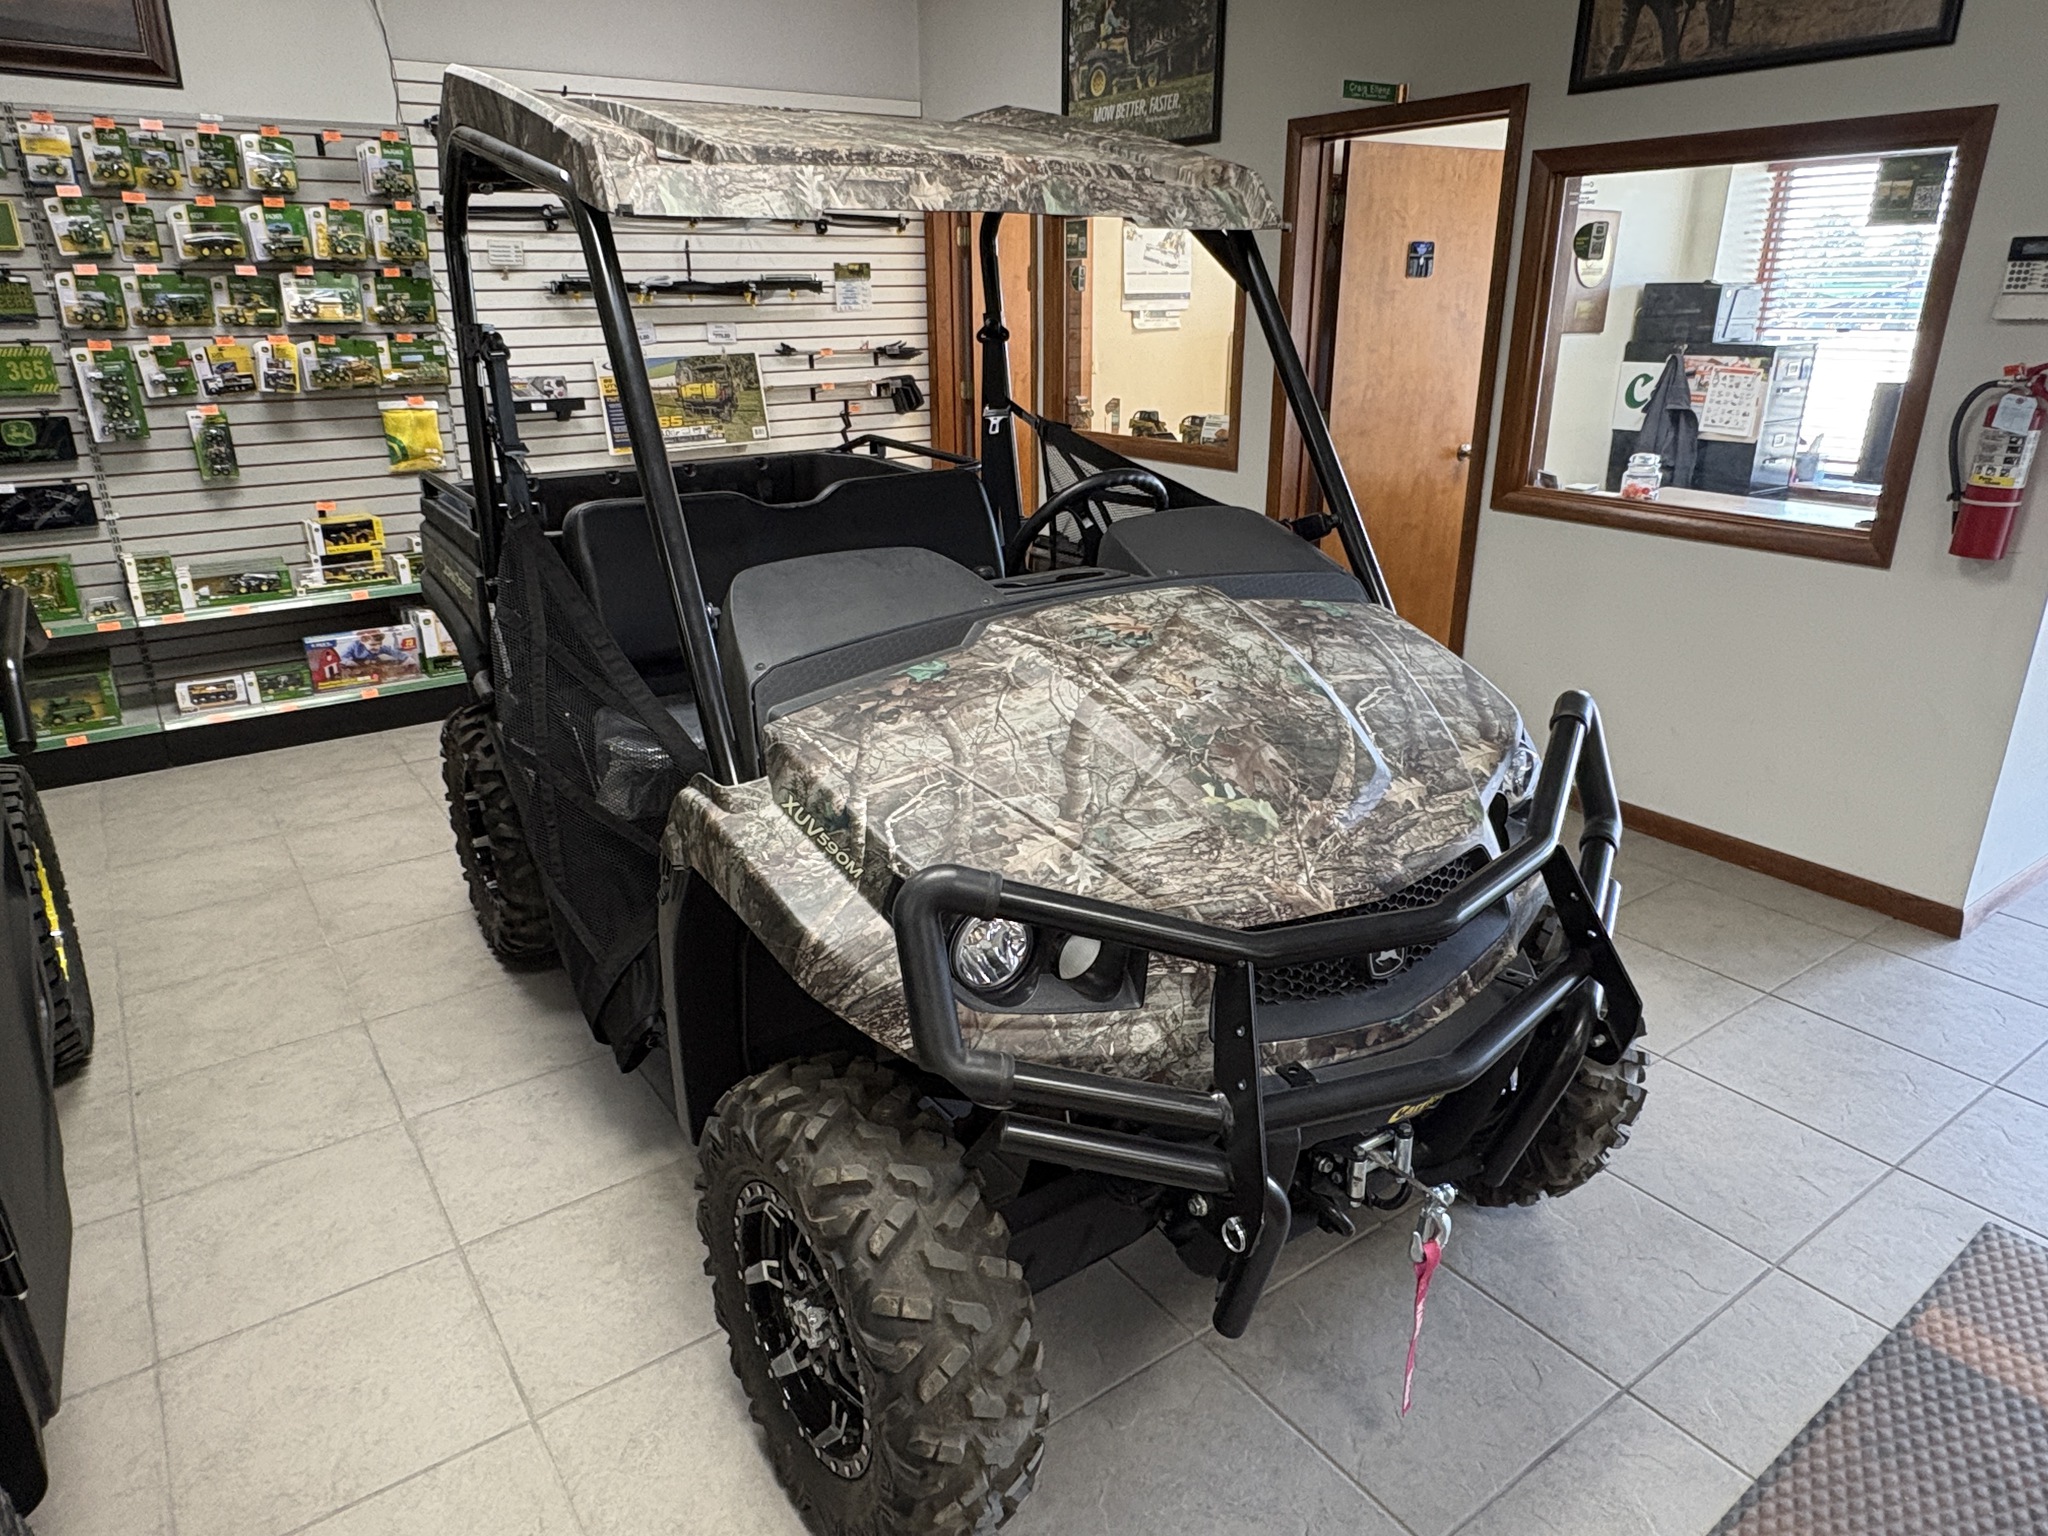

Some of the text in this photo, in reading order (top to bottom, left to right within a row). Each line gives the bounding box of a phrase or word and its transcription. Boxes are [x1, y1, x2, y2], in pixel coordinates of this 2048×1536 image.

[1092, 104, 1115, 123] MOW
[1115, 98, 1147, 119] BETTER,
[1149, 93, 1181, 114] FASTER.
[6, 360, 47, 381] 365
[781, 794, 864, 879] XUV590M
